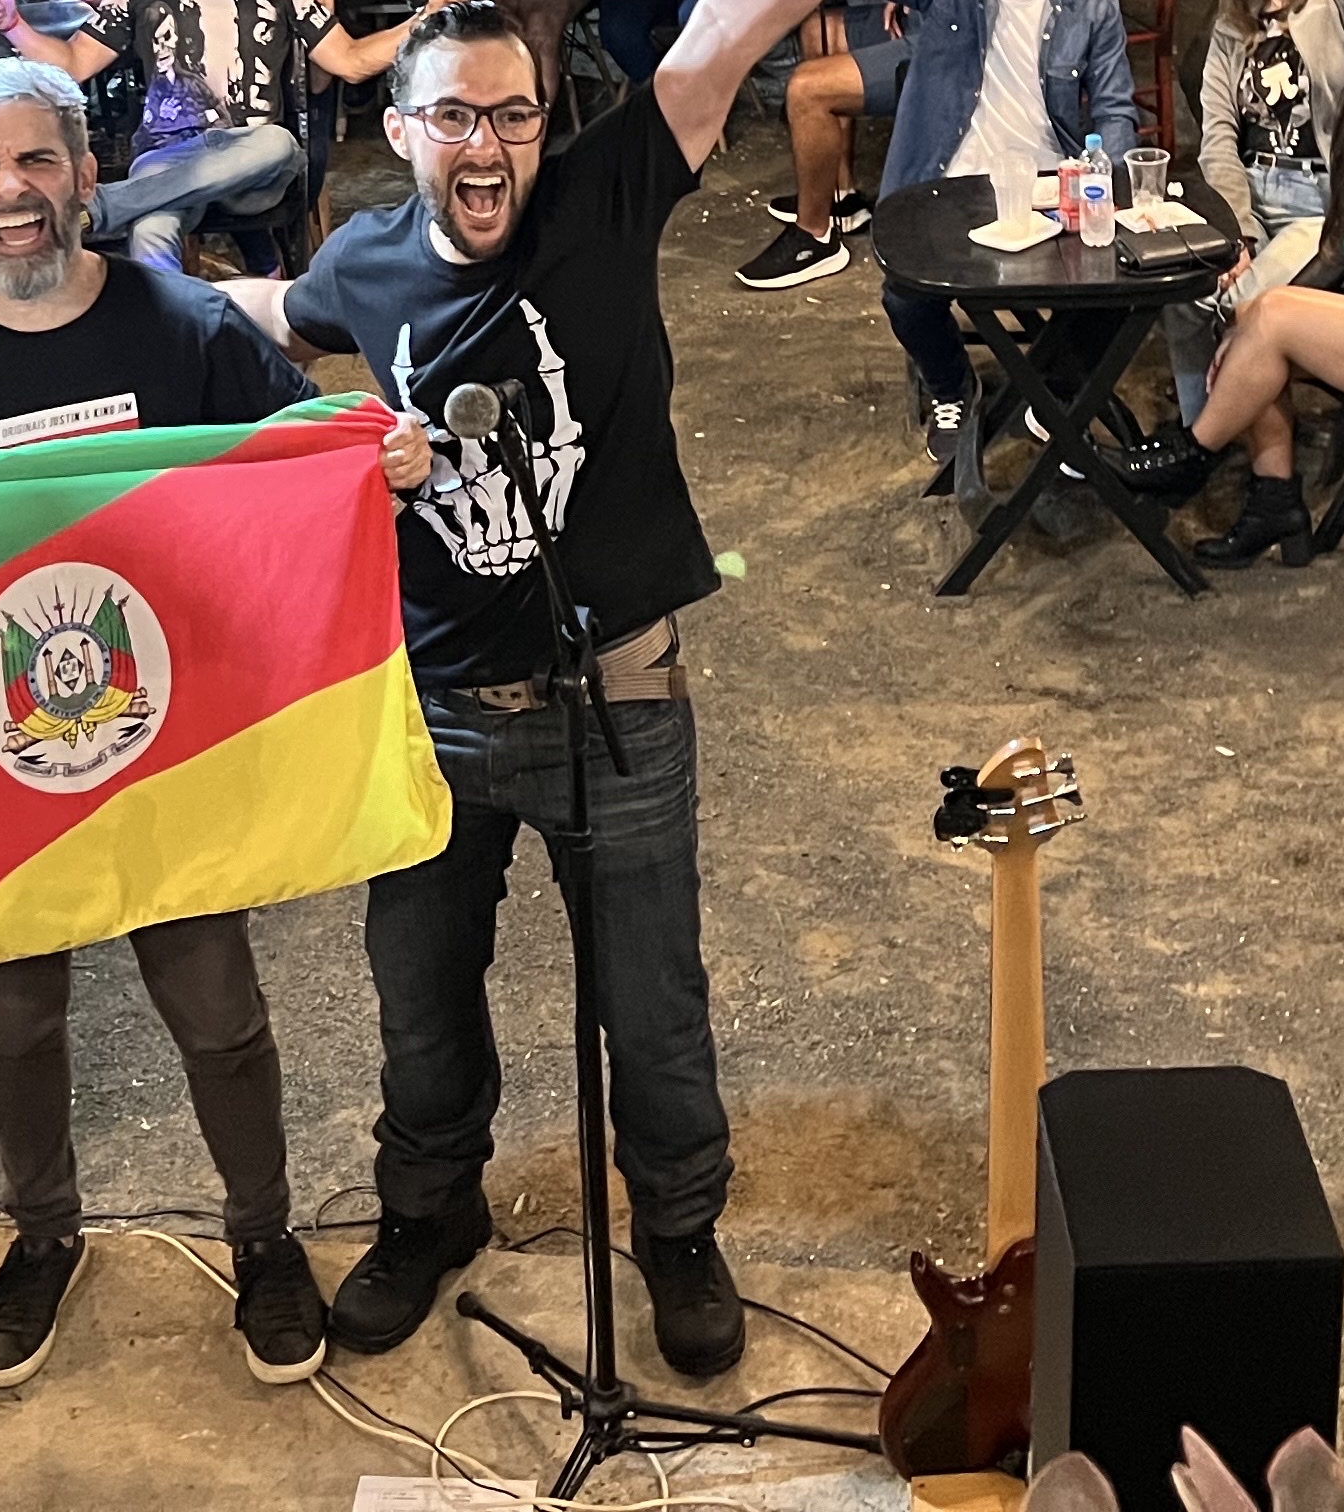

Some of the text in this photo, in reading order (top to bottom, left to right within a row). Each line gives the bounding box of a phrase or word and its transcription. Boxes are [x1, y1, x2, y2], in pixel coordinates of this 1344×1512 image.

[49, 411, 81, 428] JUSTIN
[93, 405, 115, 418] KING
[118, 401, 133, 414] JIM
